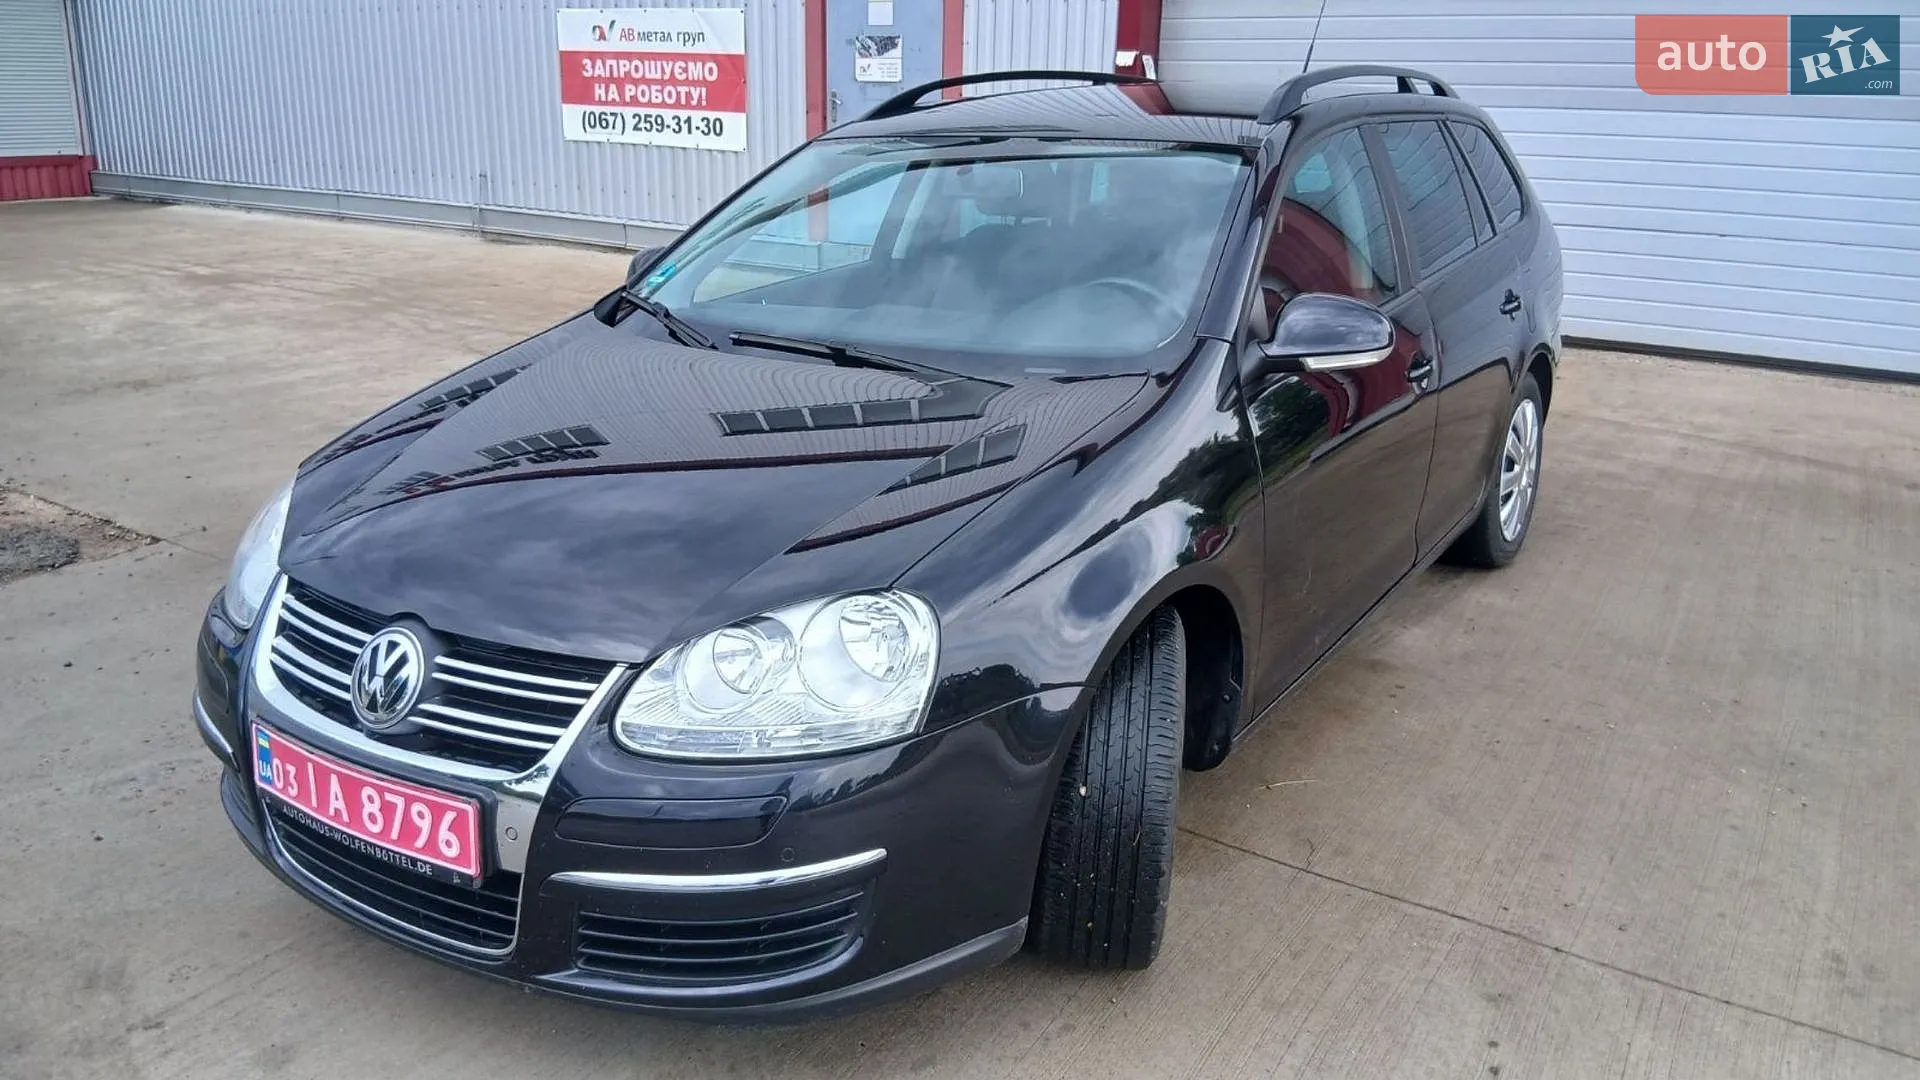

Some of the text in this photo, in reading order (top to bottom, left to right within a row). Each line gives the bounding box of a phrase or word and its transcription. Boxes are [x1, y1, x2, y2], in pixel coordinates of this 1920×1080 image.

[676, 31, 705, 47] груп
[581, 58, 719, 82] ЗАПРОШУЄМО
[593, 83, 707, 107] НА РОБОТУ!
[581, 111, 724, 137] (067) 259-31-30
[258, 759, 273, 781] UA
